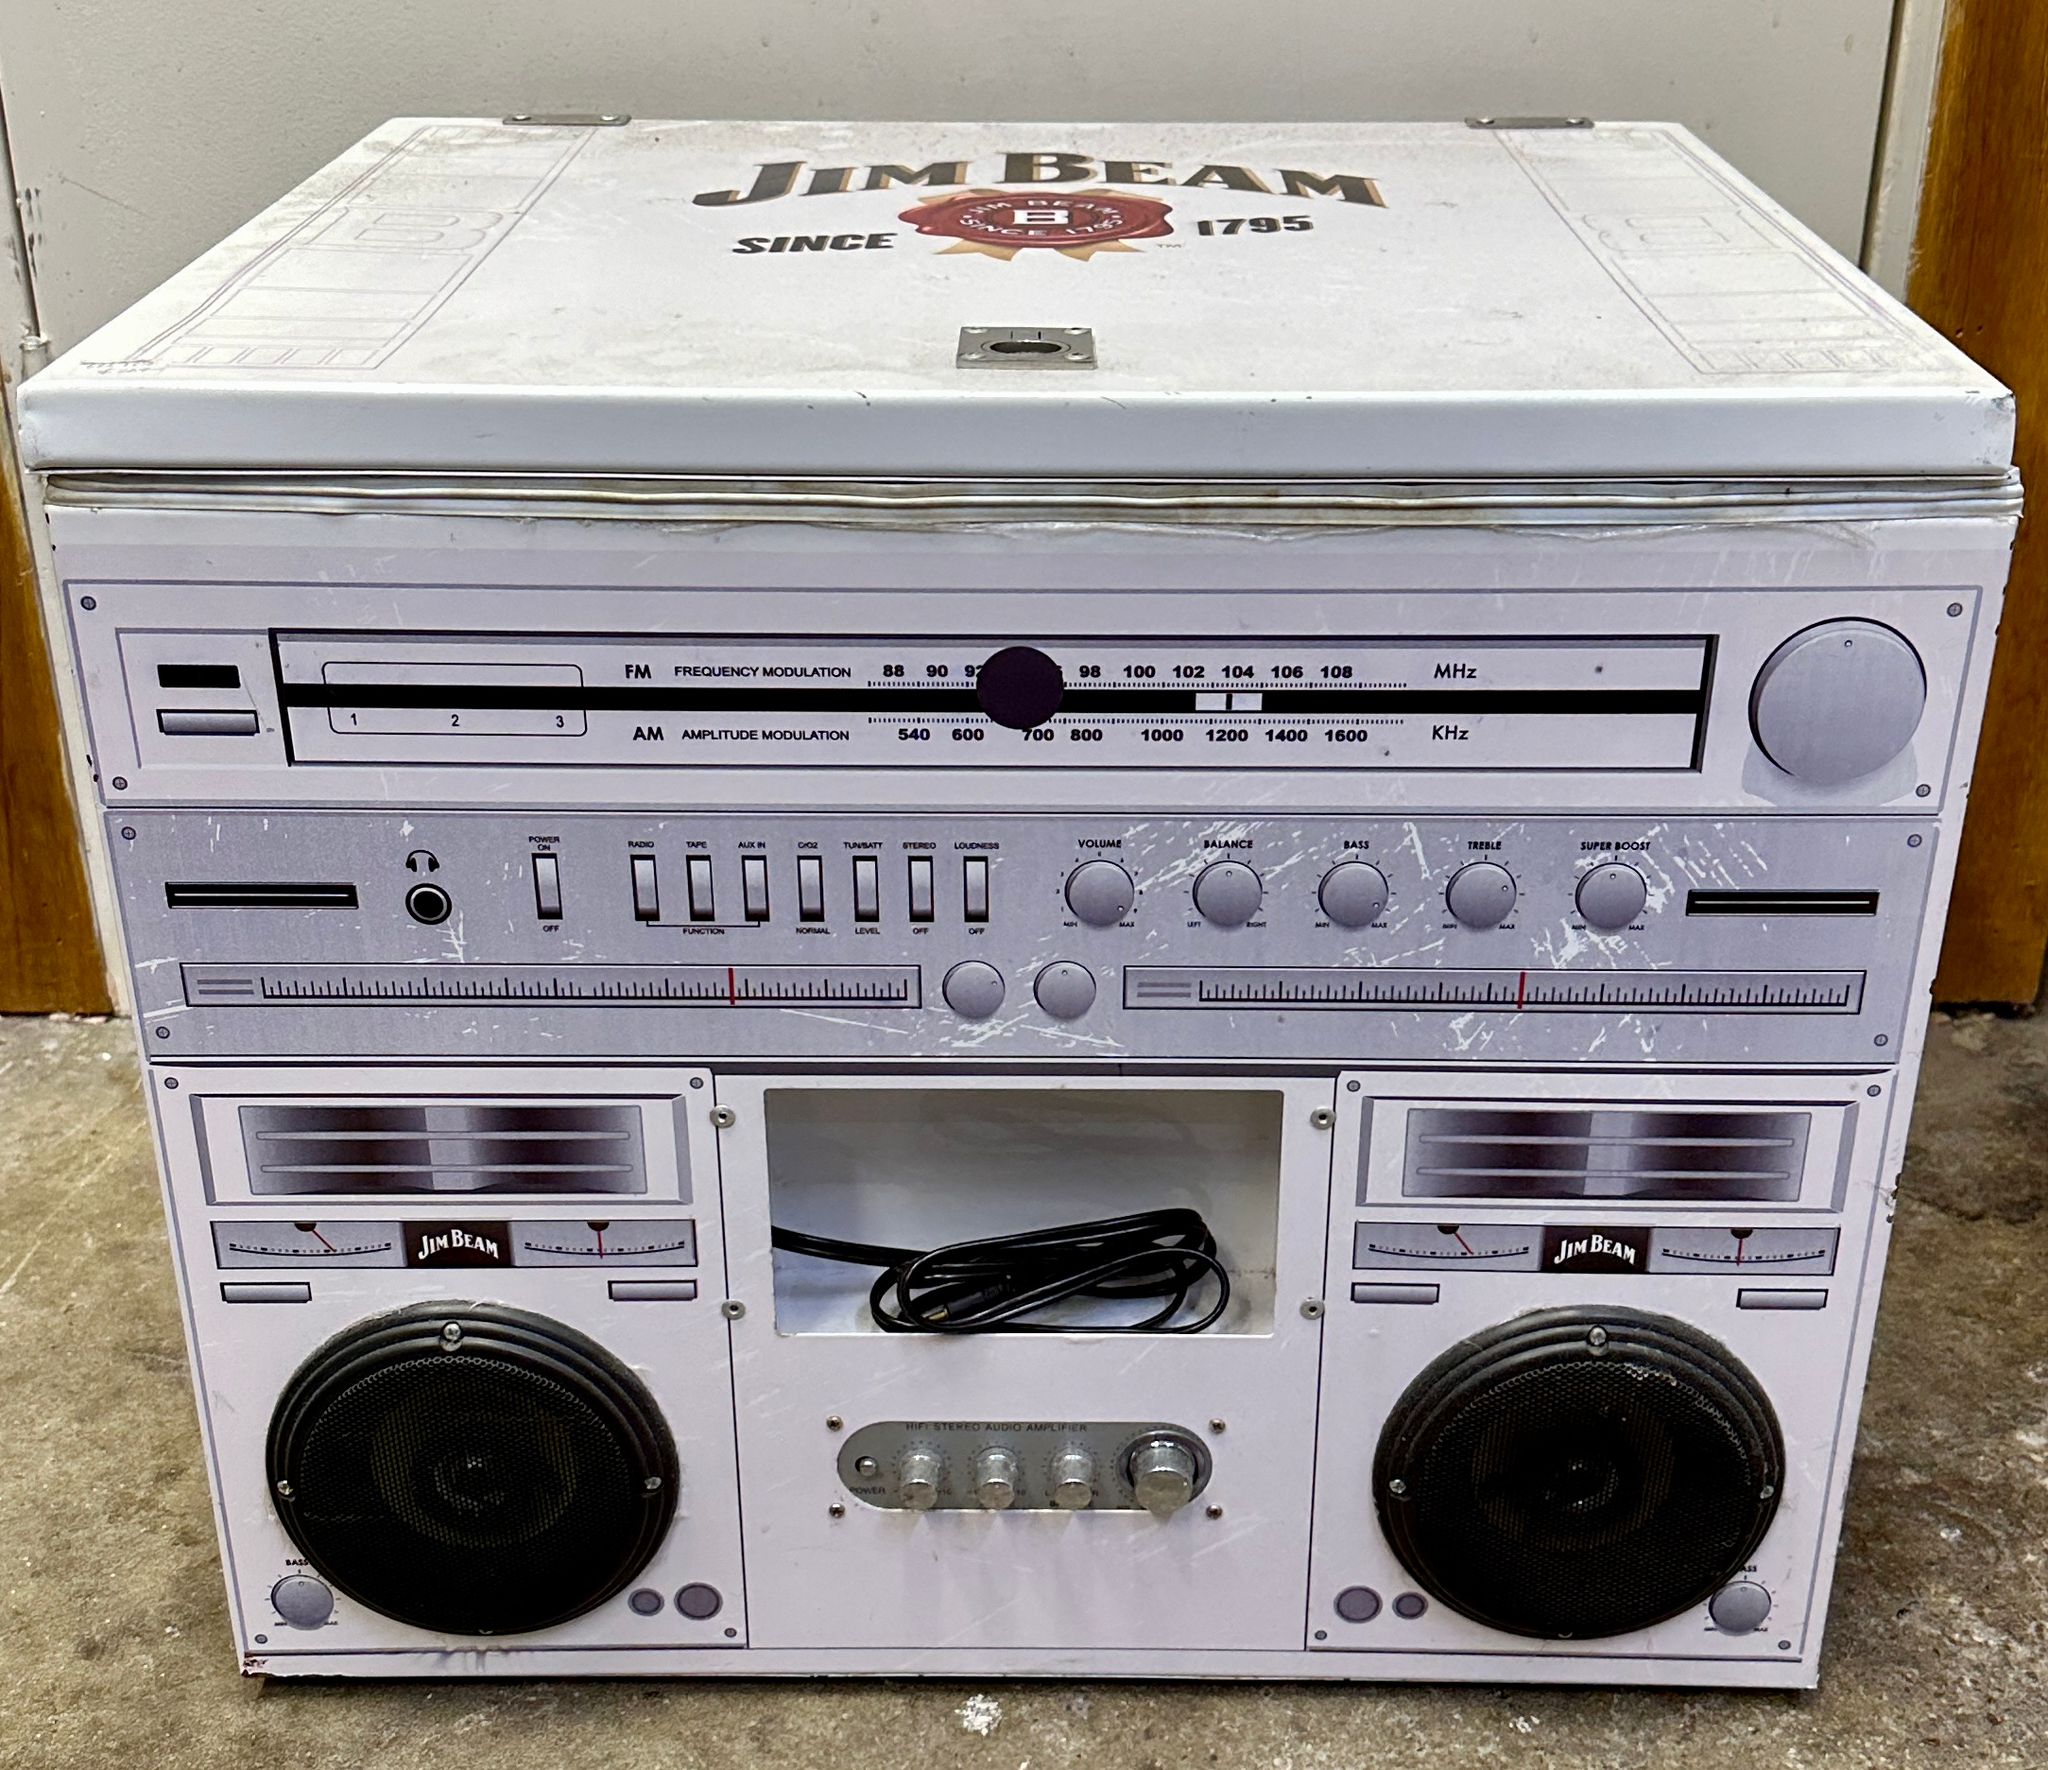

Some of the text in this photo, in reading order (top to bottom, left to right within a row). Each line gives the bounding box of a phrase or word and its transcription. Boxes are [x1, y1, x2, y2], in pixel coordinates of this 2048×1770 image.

[691, 152, 1389, 209] JIM BEAM
[968, 202, 1012, 216] JIM
[1013, 210, 1069, 225] B
[960, 215, 1048, 236] SINCE
[732, 215, 1315, 256] SINCE 1795
[624, 664, 852, 680] FM FREQUENCY MODULATION
[882, 664, 905, 678] 88
[925, 664, 949, 678] 90
[1078, 664, 1102, 679] 98
[1123, 664, 1156, 679] 100
[1172, 664, 1205, 679] 102
[1221, 665, 1255, 679] 104
[1270, 665, 1304, 679] 106
[1320, 665, 1353, 679] 108
[1433, 663, 1477, 679] MHz
[350, 712, 565, 729] 1 2 3
[632, 726, 850, 741] AM AMPLITUDE MODULATION
[897, 724, 1469, 743] 540 600 700 800 1000 1200 1400 1600 KHz
[528, 835, 561, 844] POWER
[627, 840, 655, 849] RADIO
[1077, 839, 1122, 849] VOLUME
[1203, 839, 1254, 850] BALANCE
[537, 843, 551, 852] ON
[685, 841, 708, 849] TAPE
[737, 841, 766, 849] AUX IN
[843, 841, 883, 850] TUN/BATT
[902, 841, 937, 850] STEREO
[953, 841, 1000, 850] LOUDNESS
[1343, 840, 1370, 850] BASS
[1467, 840, 1502, 851] TREBLE
[1580, 841, 1651, 851] SUPER BOOST
[542, 924, 560, 933] OFF
[682, 927, 725, 935] FUNCTION
[795, 927, 831, 935] NORMAL
[854, 927, 881, 935] LEVEL
[912, 927, 929, 935] OFF
[968, 927, 985, 935] OFF
[418, 1229, 499, 1260] JIM BEAM
[1553, 1234, 1636, 1265] JIM BEAM
[905, 1423, 1088, 1432] HIFI STEREO AUDIO AMPLIFIER
[850, 1486, 887, 1495] POWER
